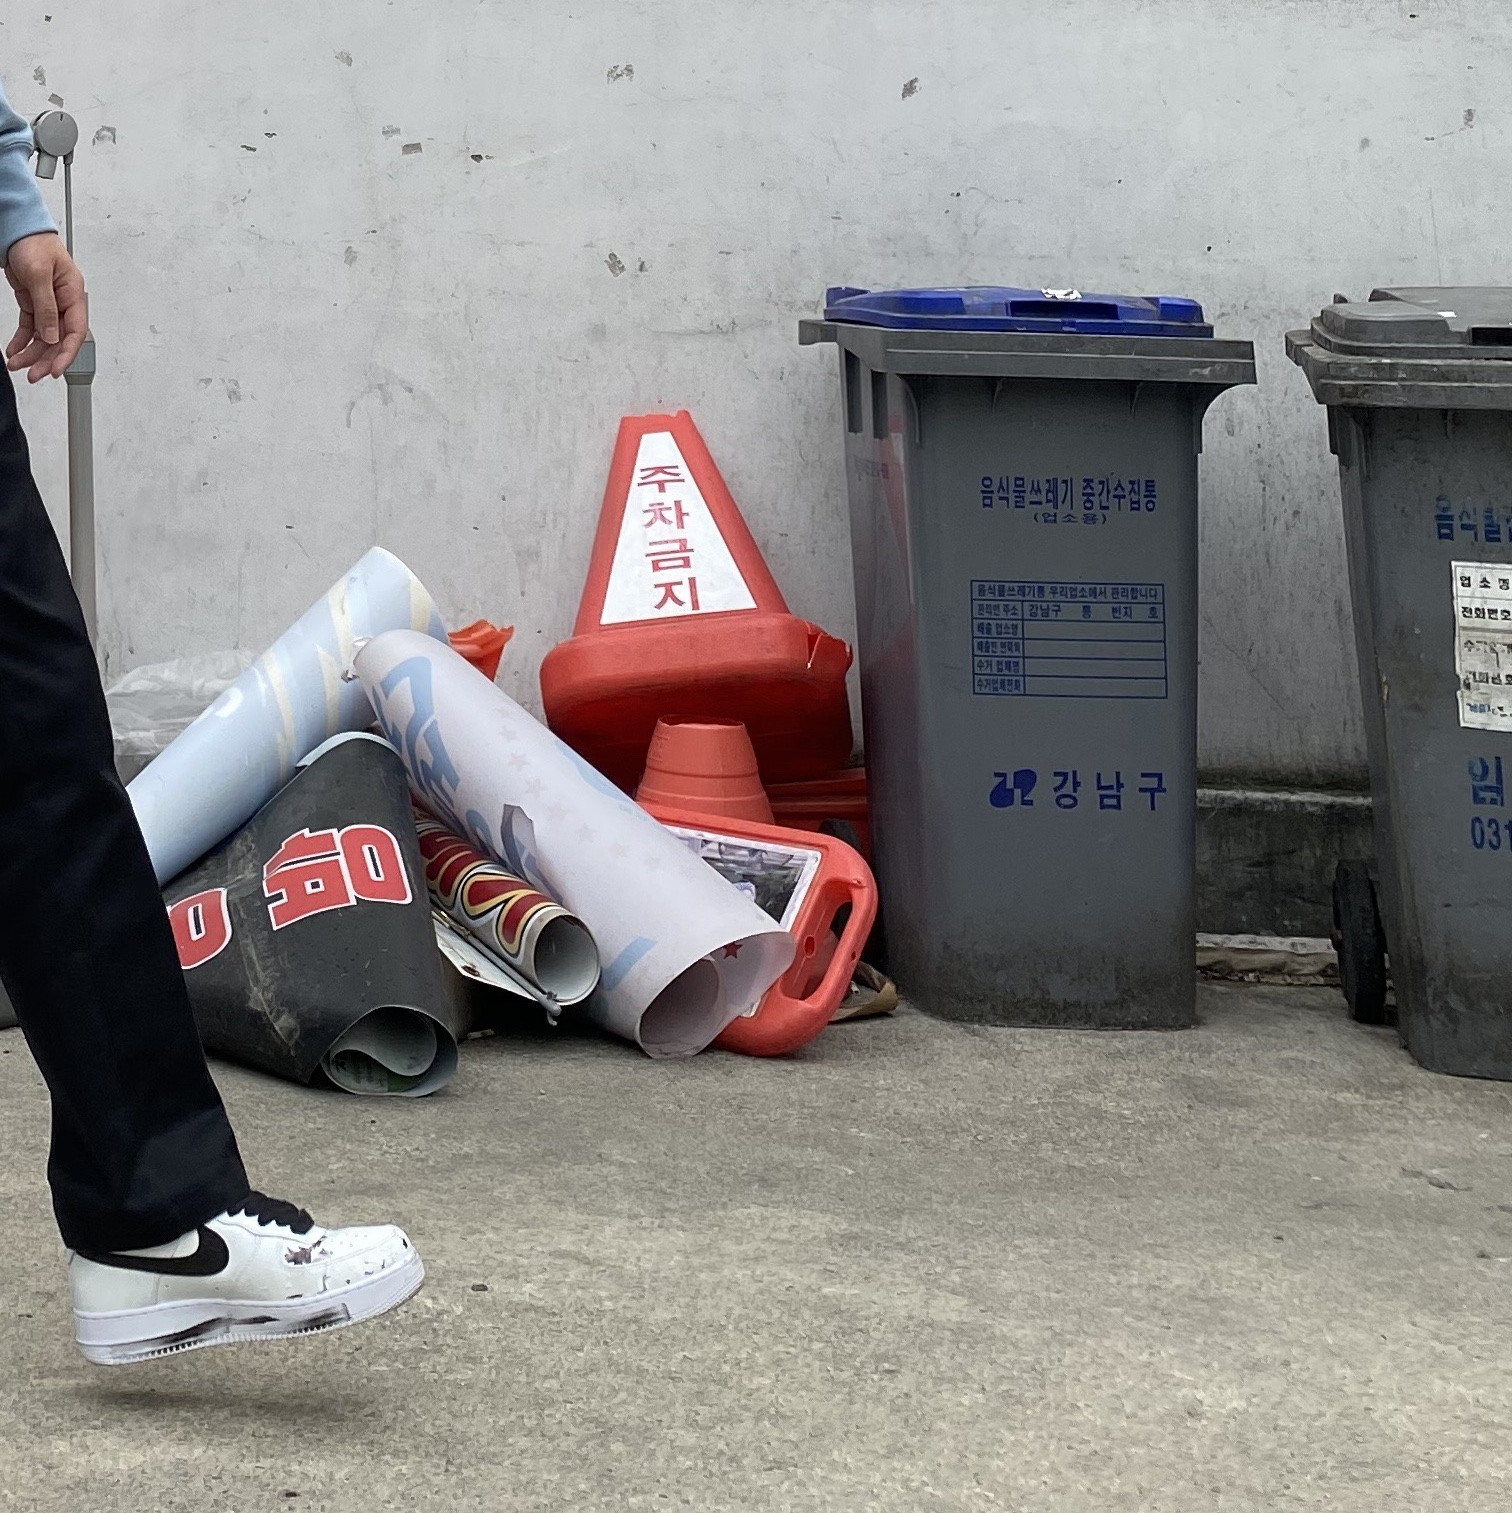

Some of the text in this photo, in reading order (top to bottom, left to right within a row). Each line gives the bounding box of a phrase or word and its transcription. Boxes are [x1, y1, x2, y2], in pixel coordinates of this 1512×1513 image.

[980, 476, 1157, 513] 음식물쓰레기 중간수집통
[637, 465, 701, 611] 주차금지
[1028, 604, 1062, 618] 강남구
[1148, 607, 1159, 620] 호
[1052, 769, 1168, 812] 강남구
